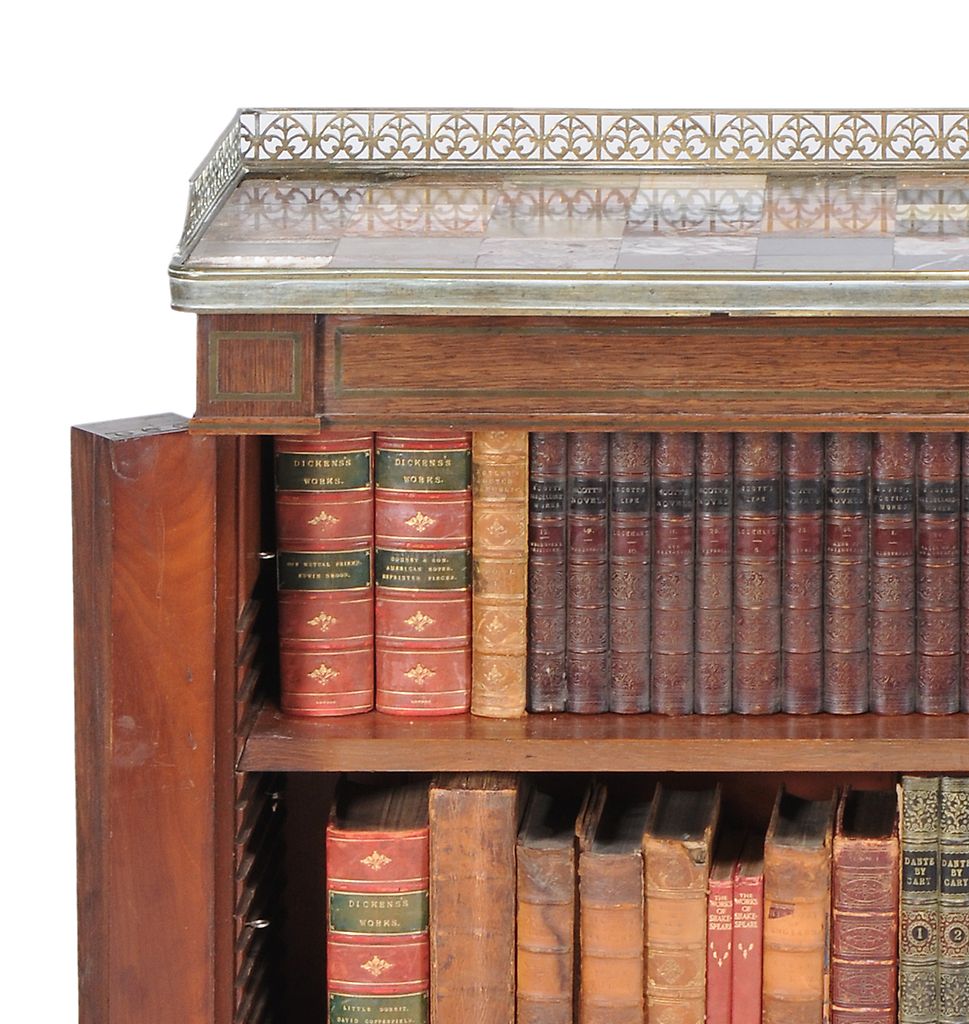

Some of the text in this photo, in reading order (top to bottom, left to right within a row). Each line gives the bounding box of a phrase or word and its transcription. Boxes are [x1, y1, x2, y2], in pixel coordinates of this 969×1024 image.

[294, 456, 352, 467] DICKENS'S
[395, 455, 451, 467] DICKENS'S
[905, 858, 934, 866] DANTE
[915, 868, 926, 876] BY
[951, 869, 962, 877] BY
[349, 897, 409, 908] DICKENS'S
[359, 919, 400, 927] WORKS.
[917, 929, 922, 939] 1
[955, 930, 962, 940] 2
